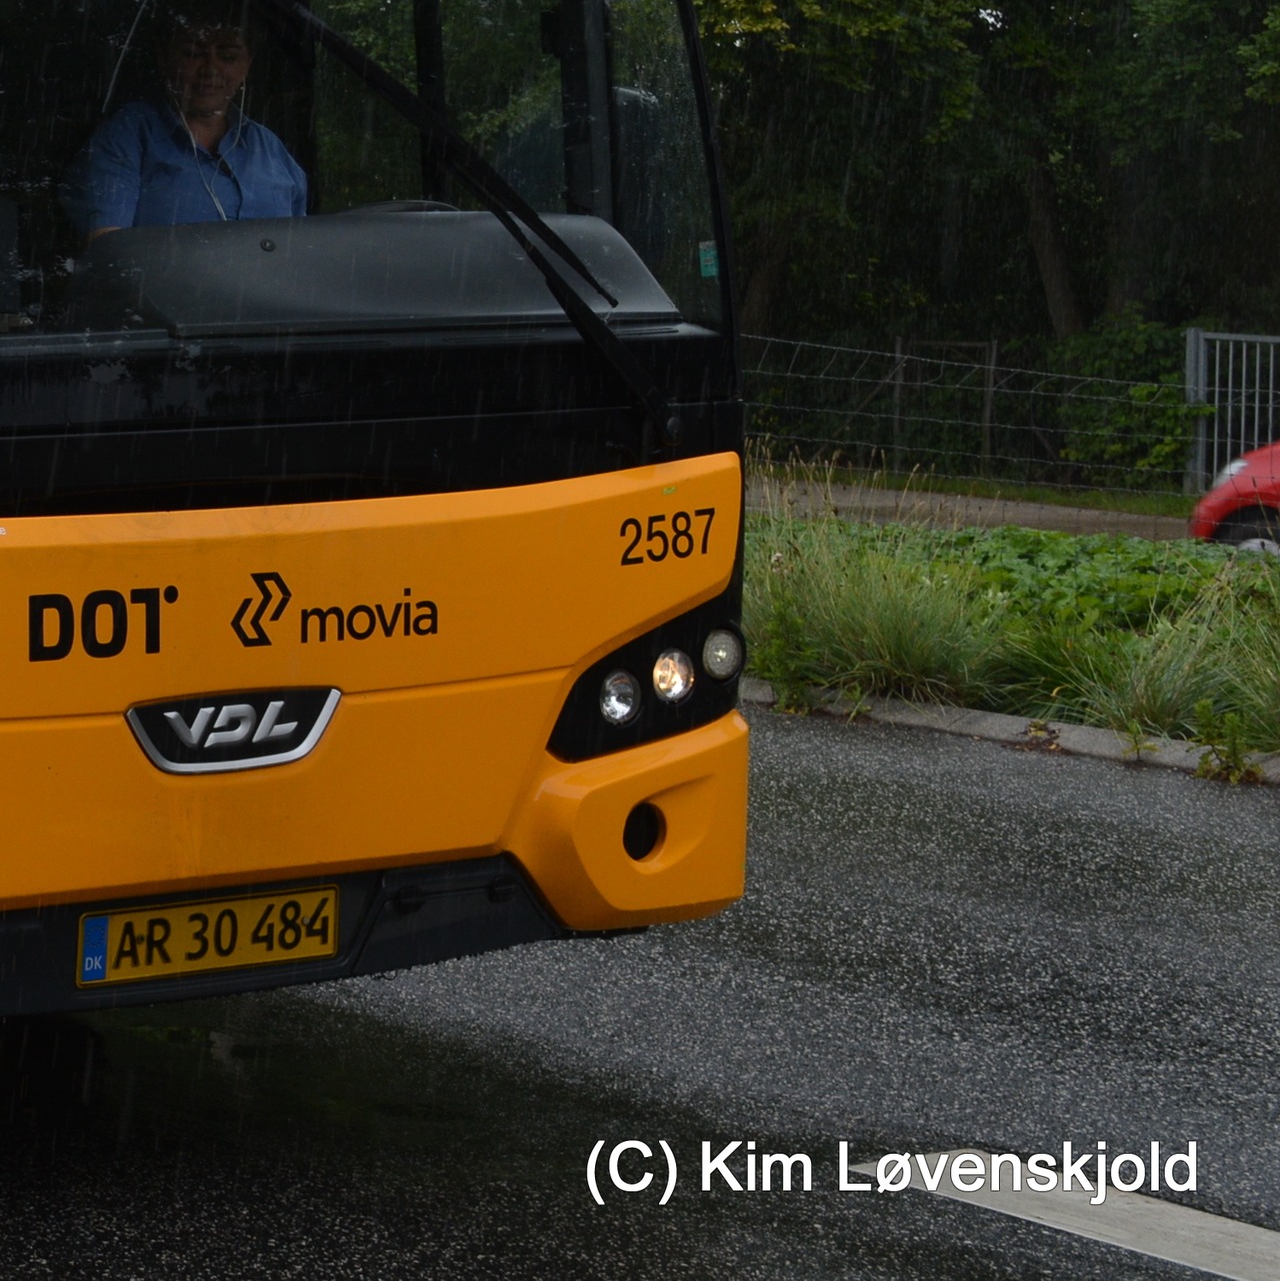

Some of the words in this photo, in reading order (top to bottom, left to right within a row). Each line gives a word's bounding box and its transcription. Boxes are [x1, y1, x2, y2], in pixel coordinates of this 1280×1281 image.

[619, 507, 716, 567] 2587
[28, 586, 164, 662] DOT
[300, 588, 438, 644] movia
[163, 700, 298, 748] VDL
[113, 917, 172, 971] AR
[185, 909, 239, 962] 30
[251, 895, 332, 955] 484
[83, 953, 103, 972] DK
